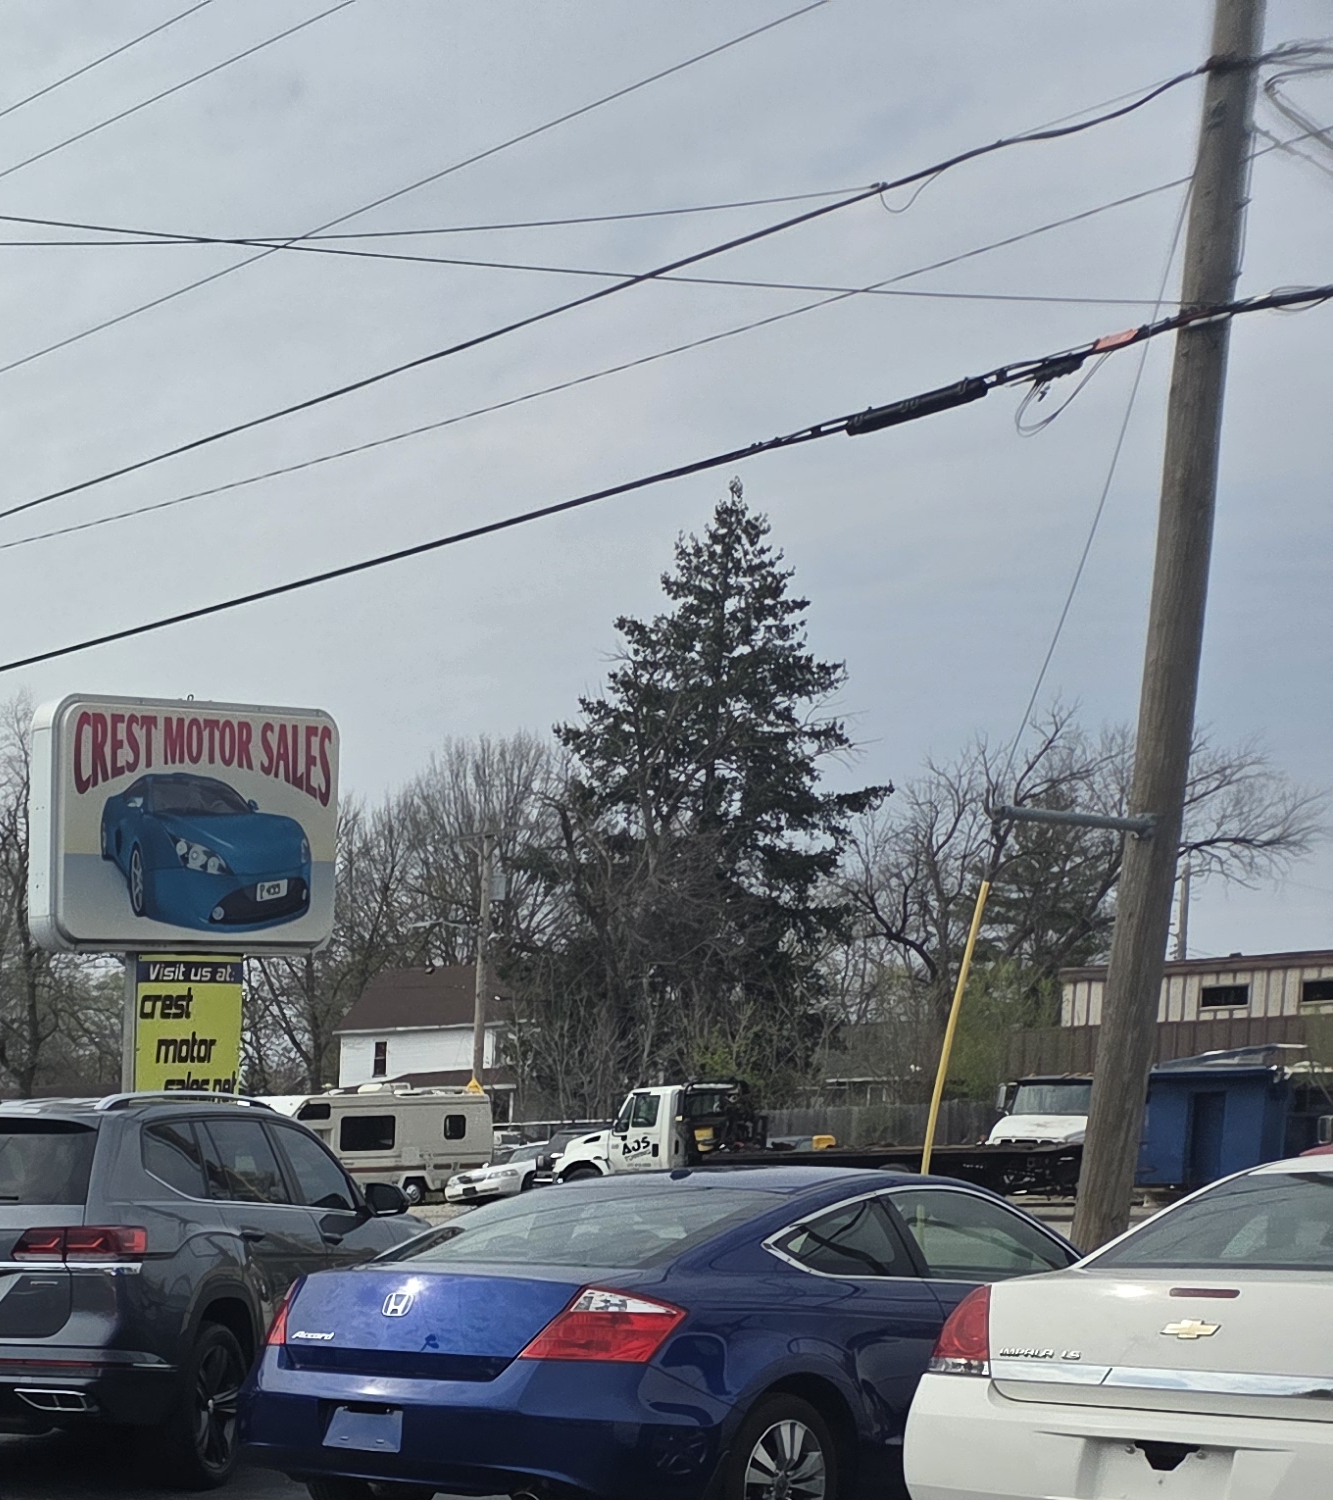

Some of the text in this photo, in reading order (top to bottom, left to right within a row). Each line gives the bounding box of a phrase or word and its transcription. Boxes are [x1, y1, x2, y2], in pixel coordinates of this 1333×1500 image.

[73, 711, 332, 807] CREST MOTOR SALES
[149, 963, 185, 981] Visit
[190, 967, 212, 981] us
[139, 986, 193, 1019] crest
[155, 1031, 217, 1064] motor
[999, 1347, 1055, 1359] IMPALA
